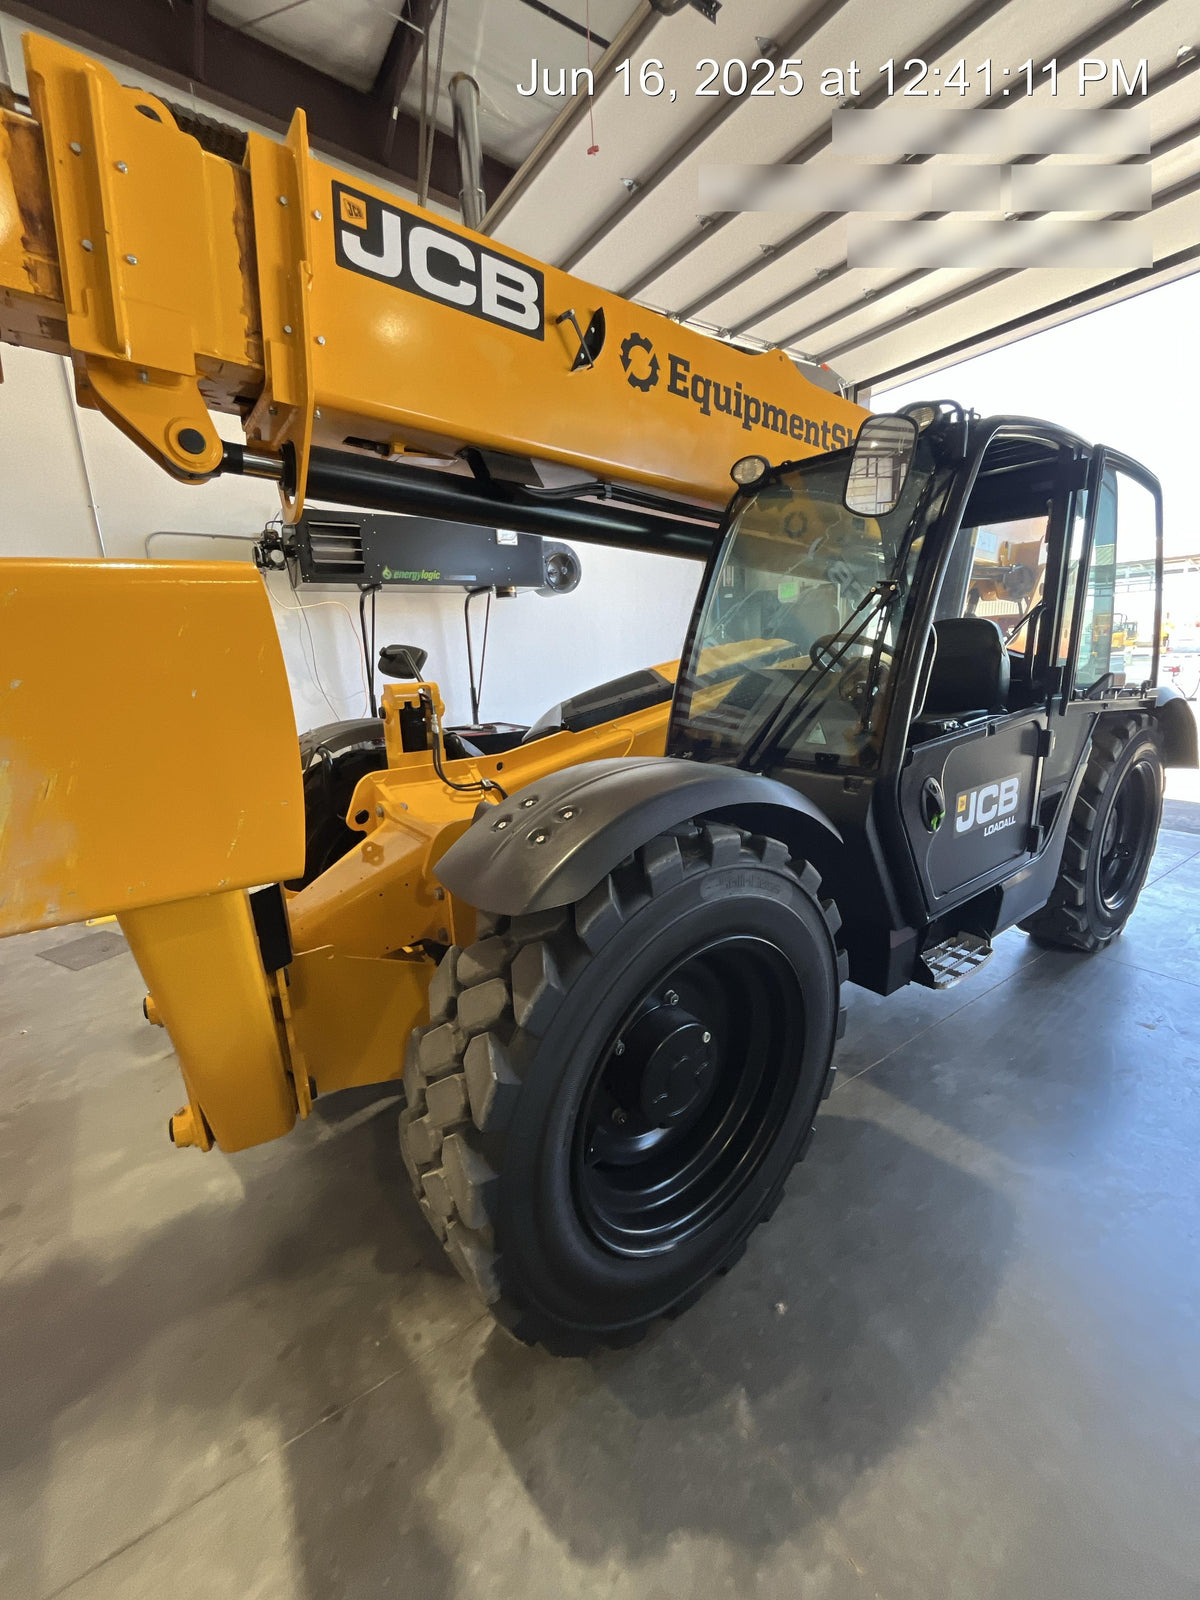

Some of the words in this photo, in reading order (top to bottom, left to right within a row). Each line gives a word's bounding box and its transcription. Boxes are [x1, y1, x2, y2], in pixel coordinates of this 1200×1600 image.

[341, 209, 540, 330] JCB
[393, 569, 441, 581] energylogic
[956, 777, 1019, 833] JCB
[984, 815, 1016, 837] LOADALL
